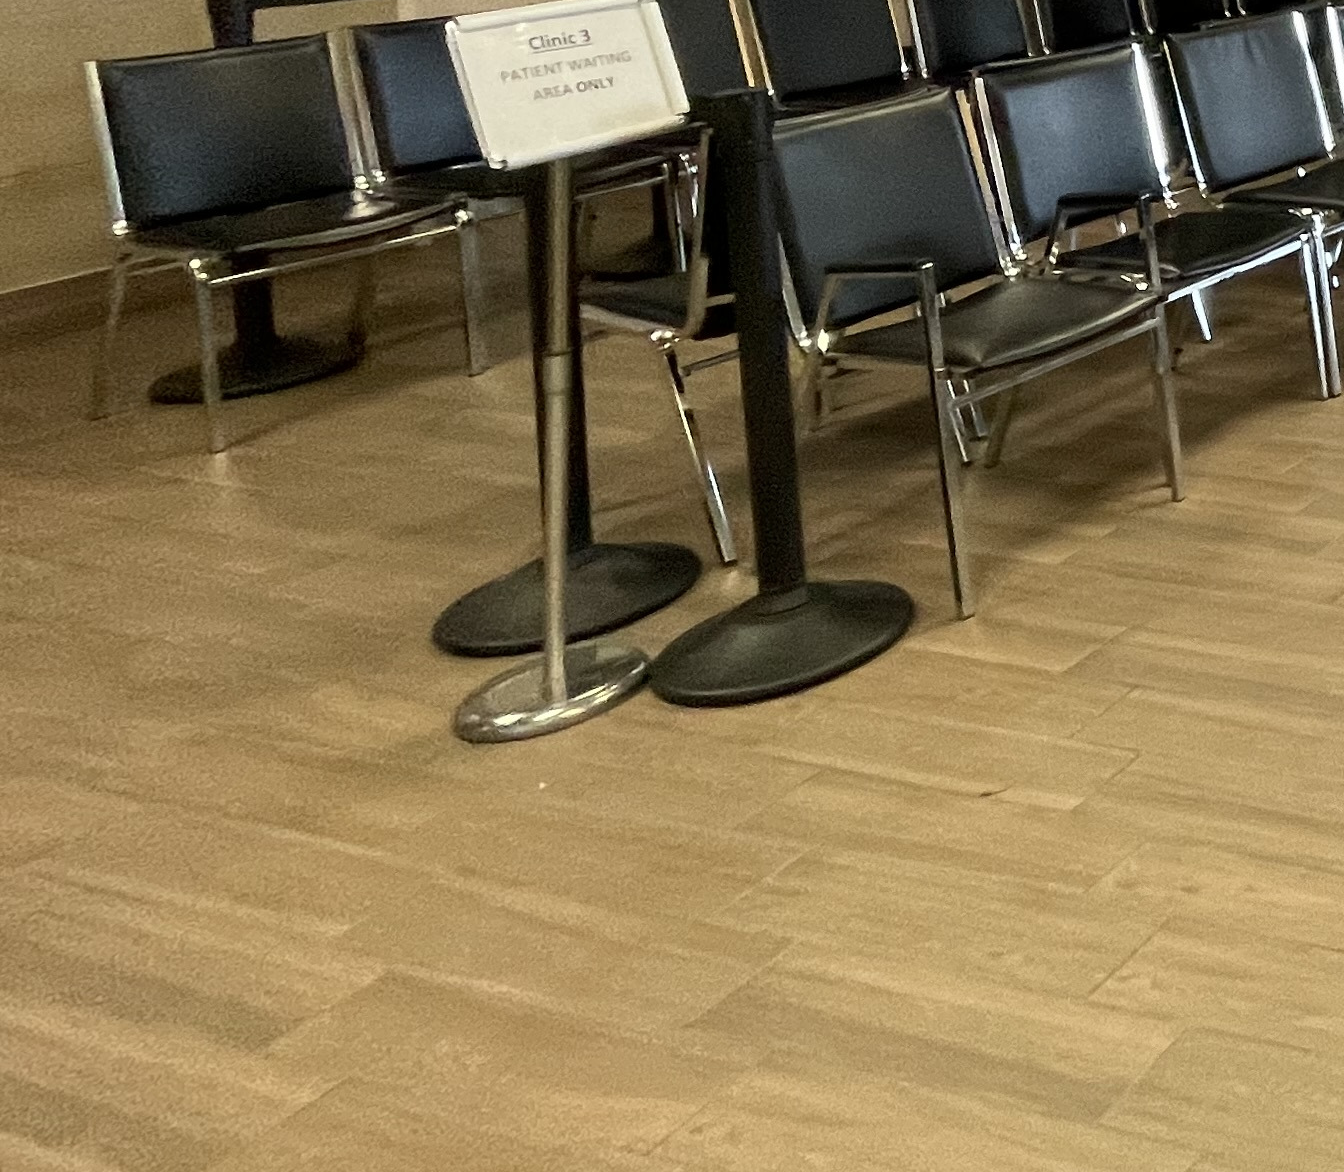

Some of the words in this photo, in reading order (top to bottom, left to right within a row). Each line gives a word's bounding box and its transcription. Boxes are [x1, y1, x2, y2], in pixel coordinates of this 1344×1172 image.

[528, 33, 576, 50] Clinic
[580, 29, 592, 43] 3
[500, 61, 563, 82] PATIENT
[567, 50, 632, 71] WAITING
[533, 84, 573, 101] AREA
[576, 77, 615, 93] ONLY
